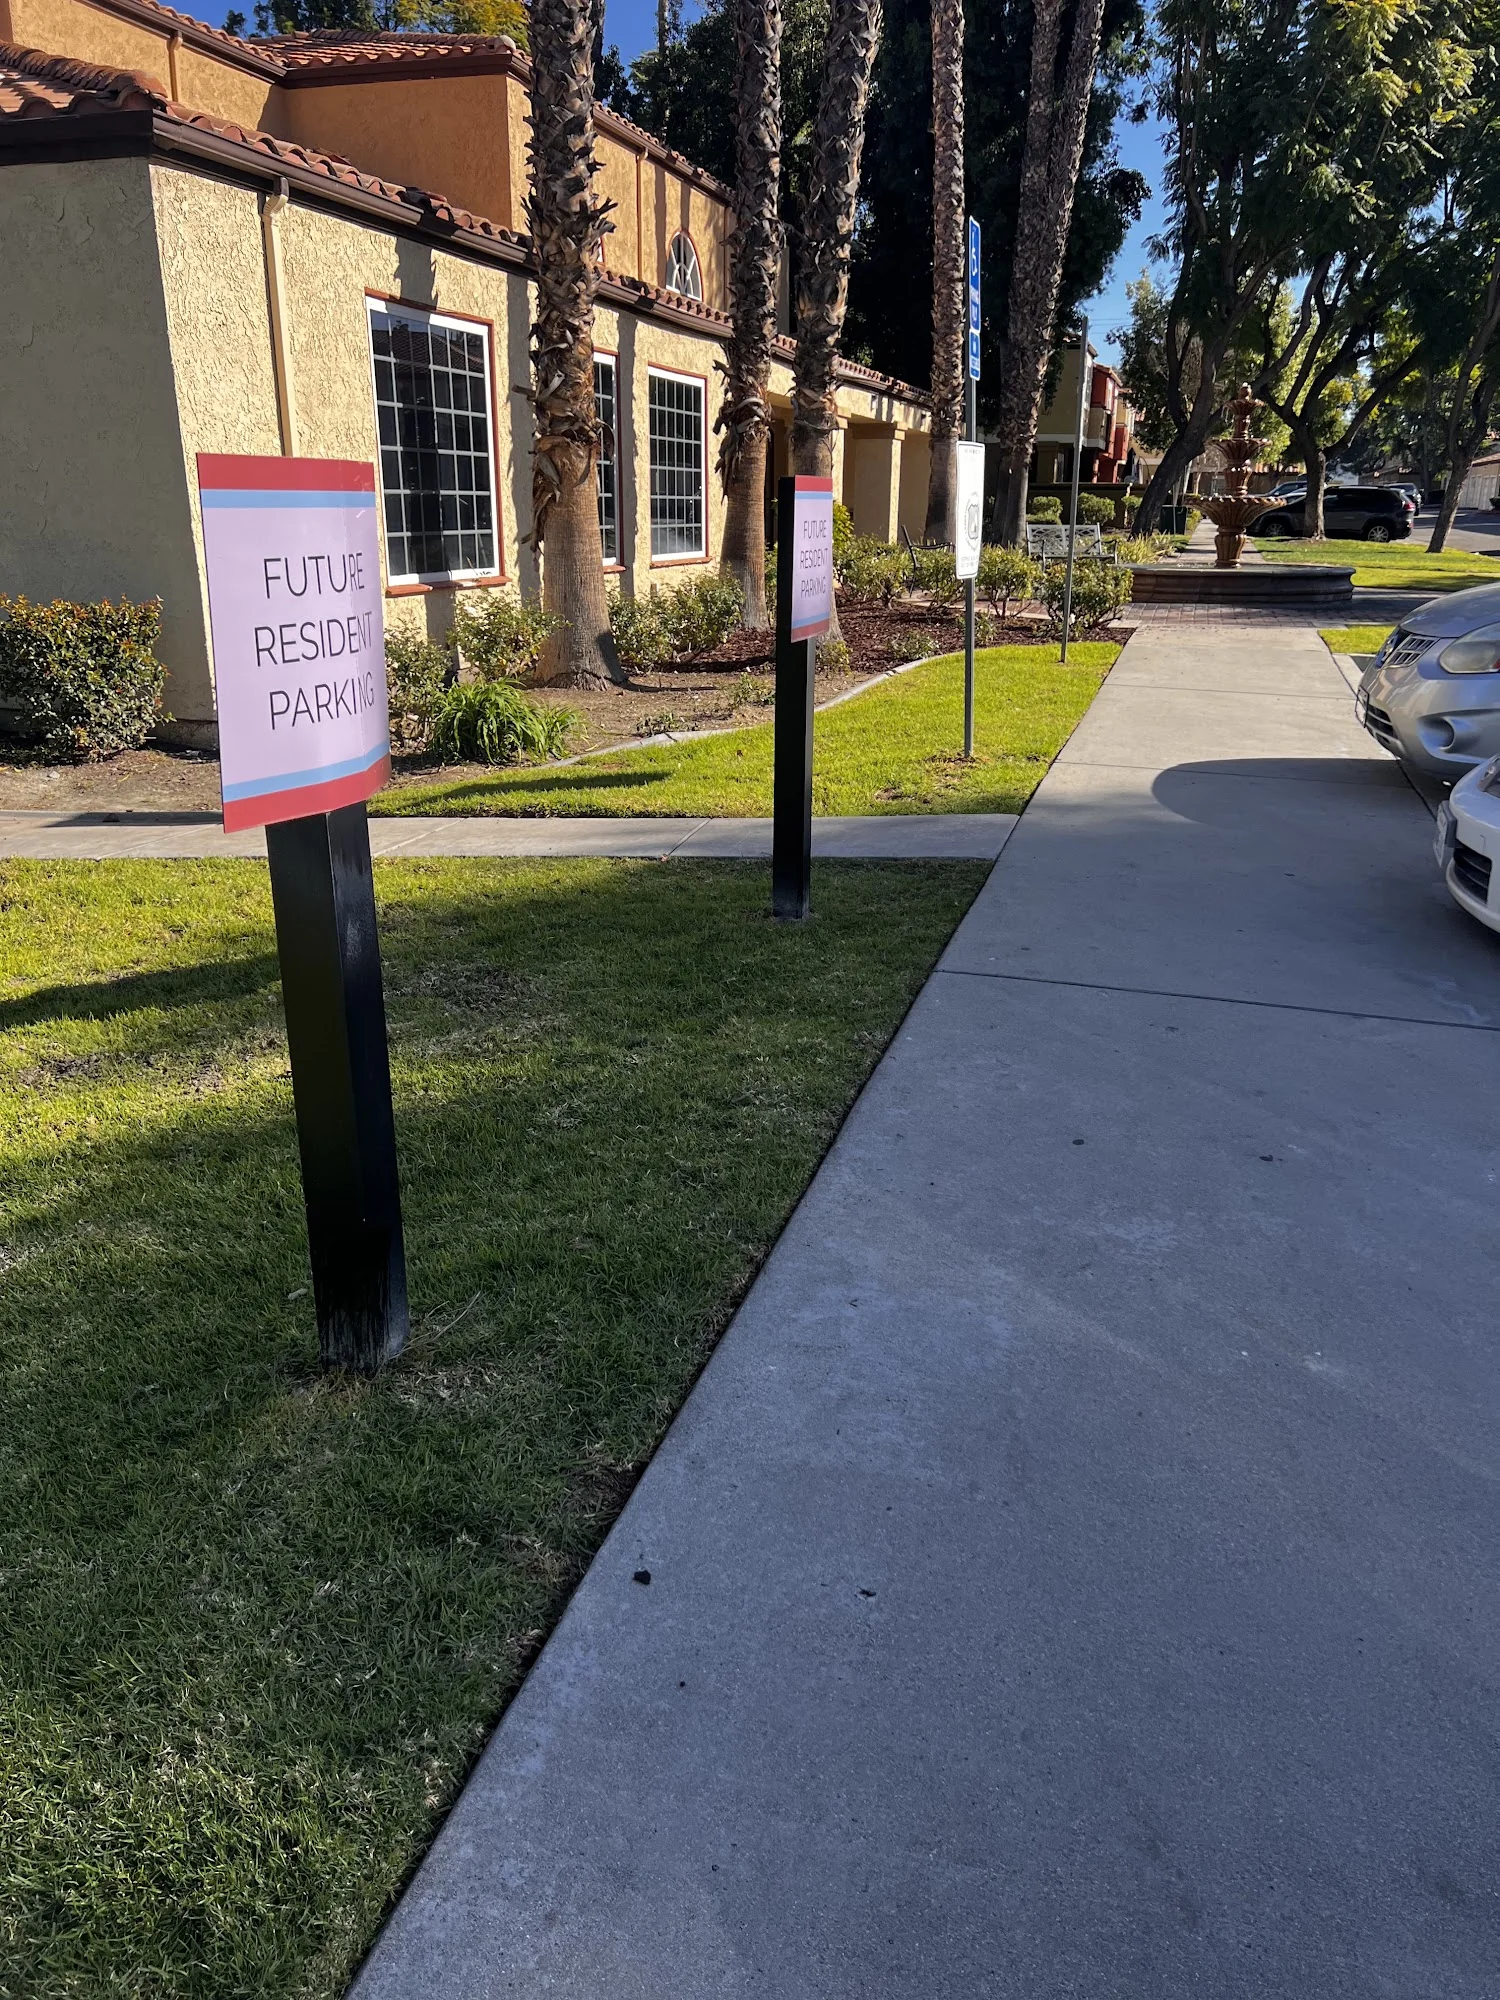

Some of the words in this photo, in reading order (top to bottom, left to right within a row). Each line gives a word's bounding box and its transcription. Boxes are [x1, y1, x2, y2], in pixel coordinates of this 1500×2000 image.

[803, 520, 827, 539] FUTURE
[264, 552, 365, 599] FUTURE
[800, 548, 829, 570] RESIDENT
[801, 576, 826, 598] PARKING
[254, 611, 373, 667] RESIDENT
[269, 671, 375, 731] PARKING
